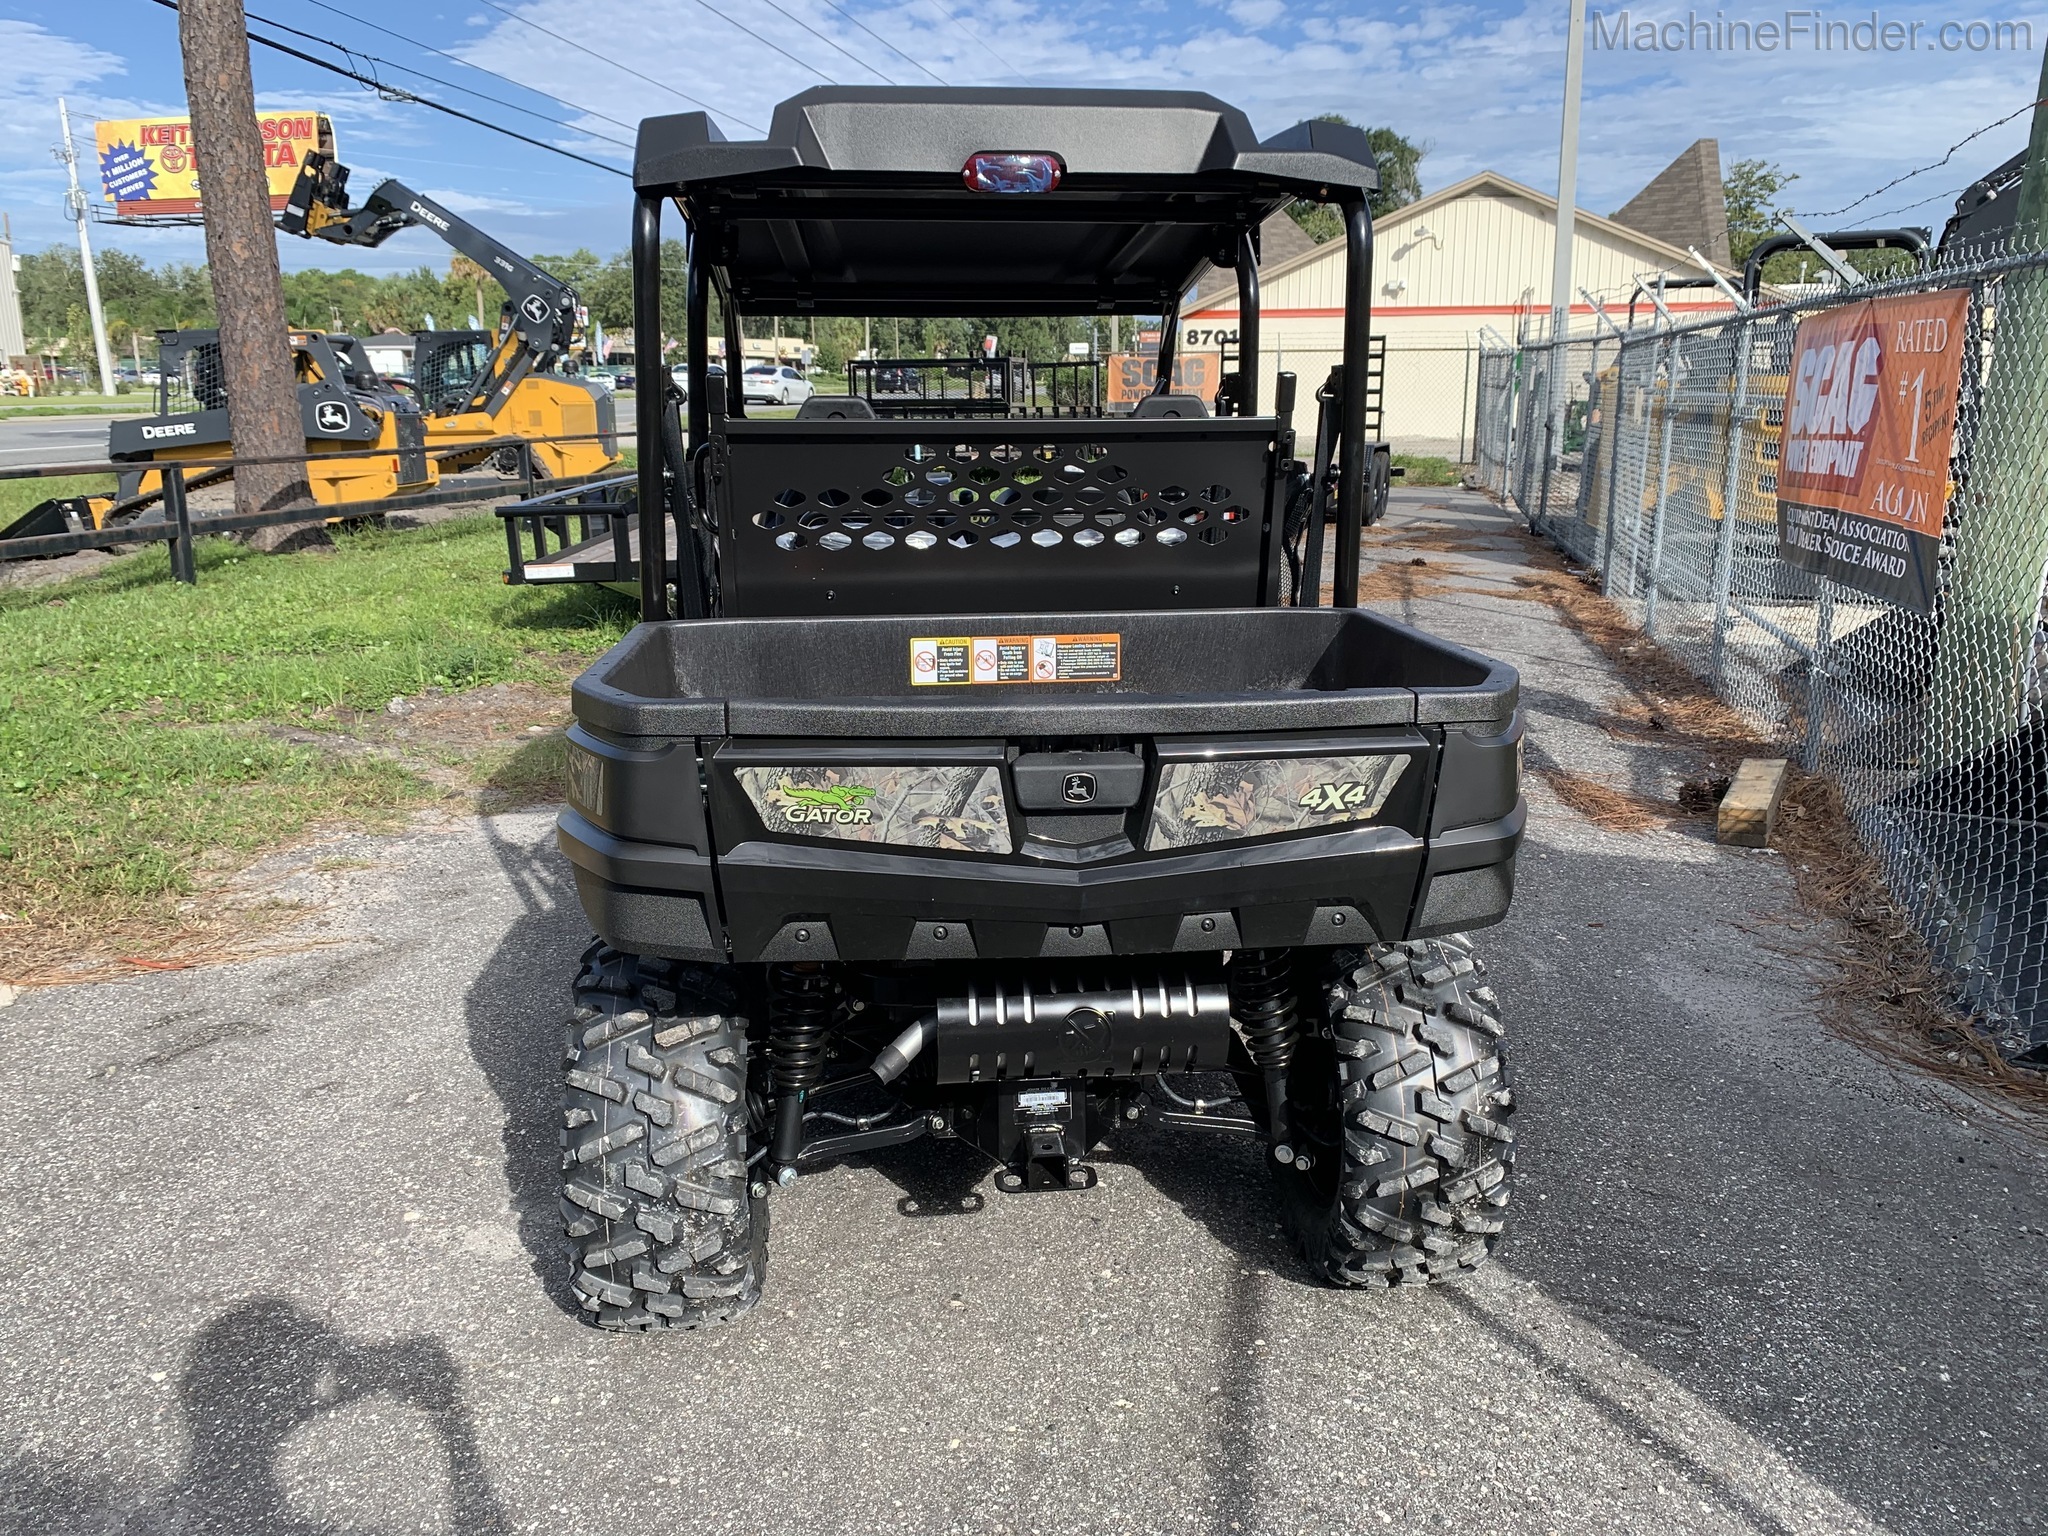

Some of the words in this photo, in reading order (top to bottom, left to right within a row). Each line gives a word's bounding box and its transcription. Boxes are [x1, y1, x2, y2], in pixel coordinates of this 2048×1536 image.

[140, 124, 193, 147] KEIT
[111, 157, 144, 176] MILLION
[113, 153, 129, 164] OVER
[108, 168, 148, 189] CUSTOMERS
[119, 181, 145, 196] SERVED
[409, 200, 451, 232] DEERE
[1186, 329, 1239, 345] 8701
[1895, 318, 1948, 354] RATED
[1791, 337, 1881, 435] SCAG
[141, 423, 196, 439] DEERE
[1861, 546, 1907, 579] AWARD
[1299, 782, 1367, 813] 4X4
[785, 804, 873, 825] GATOR
